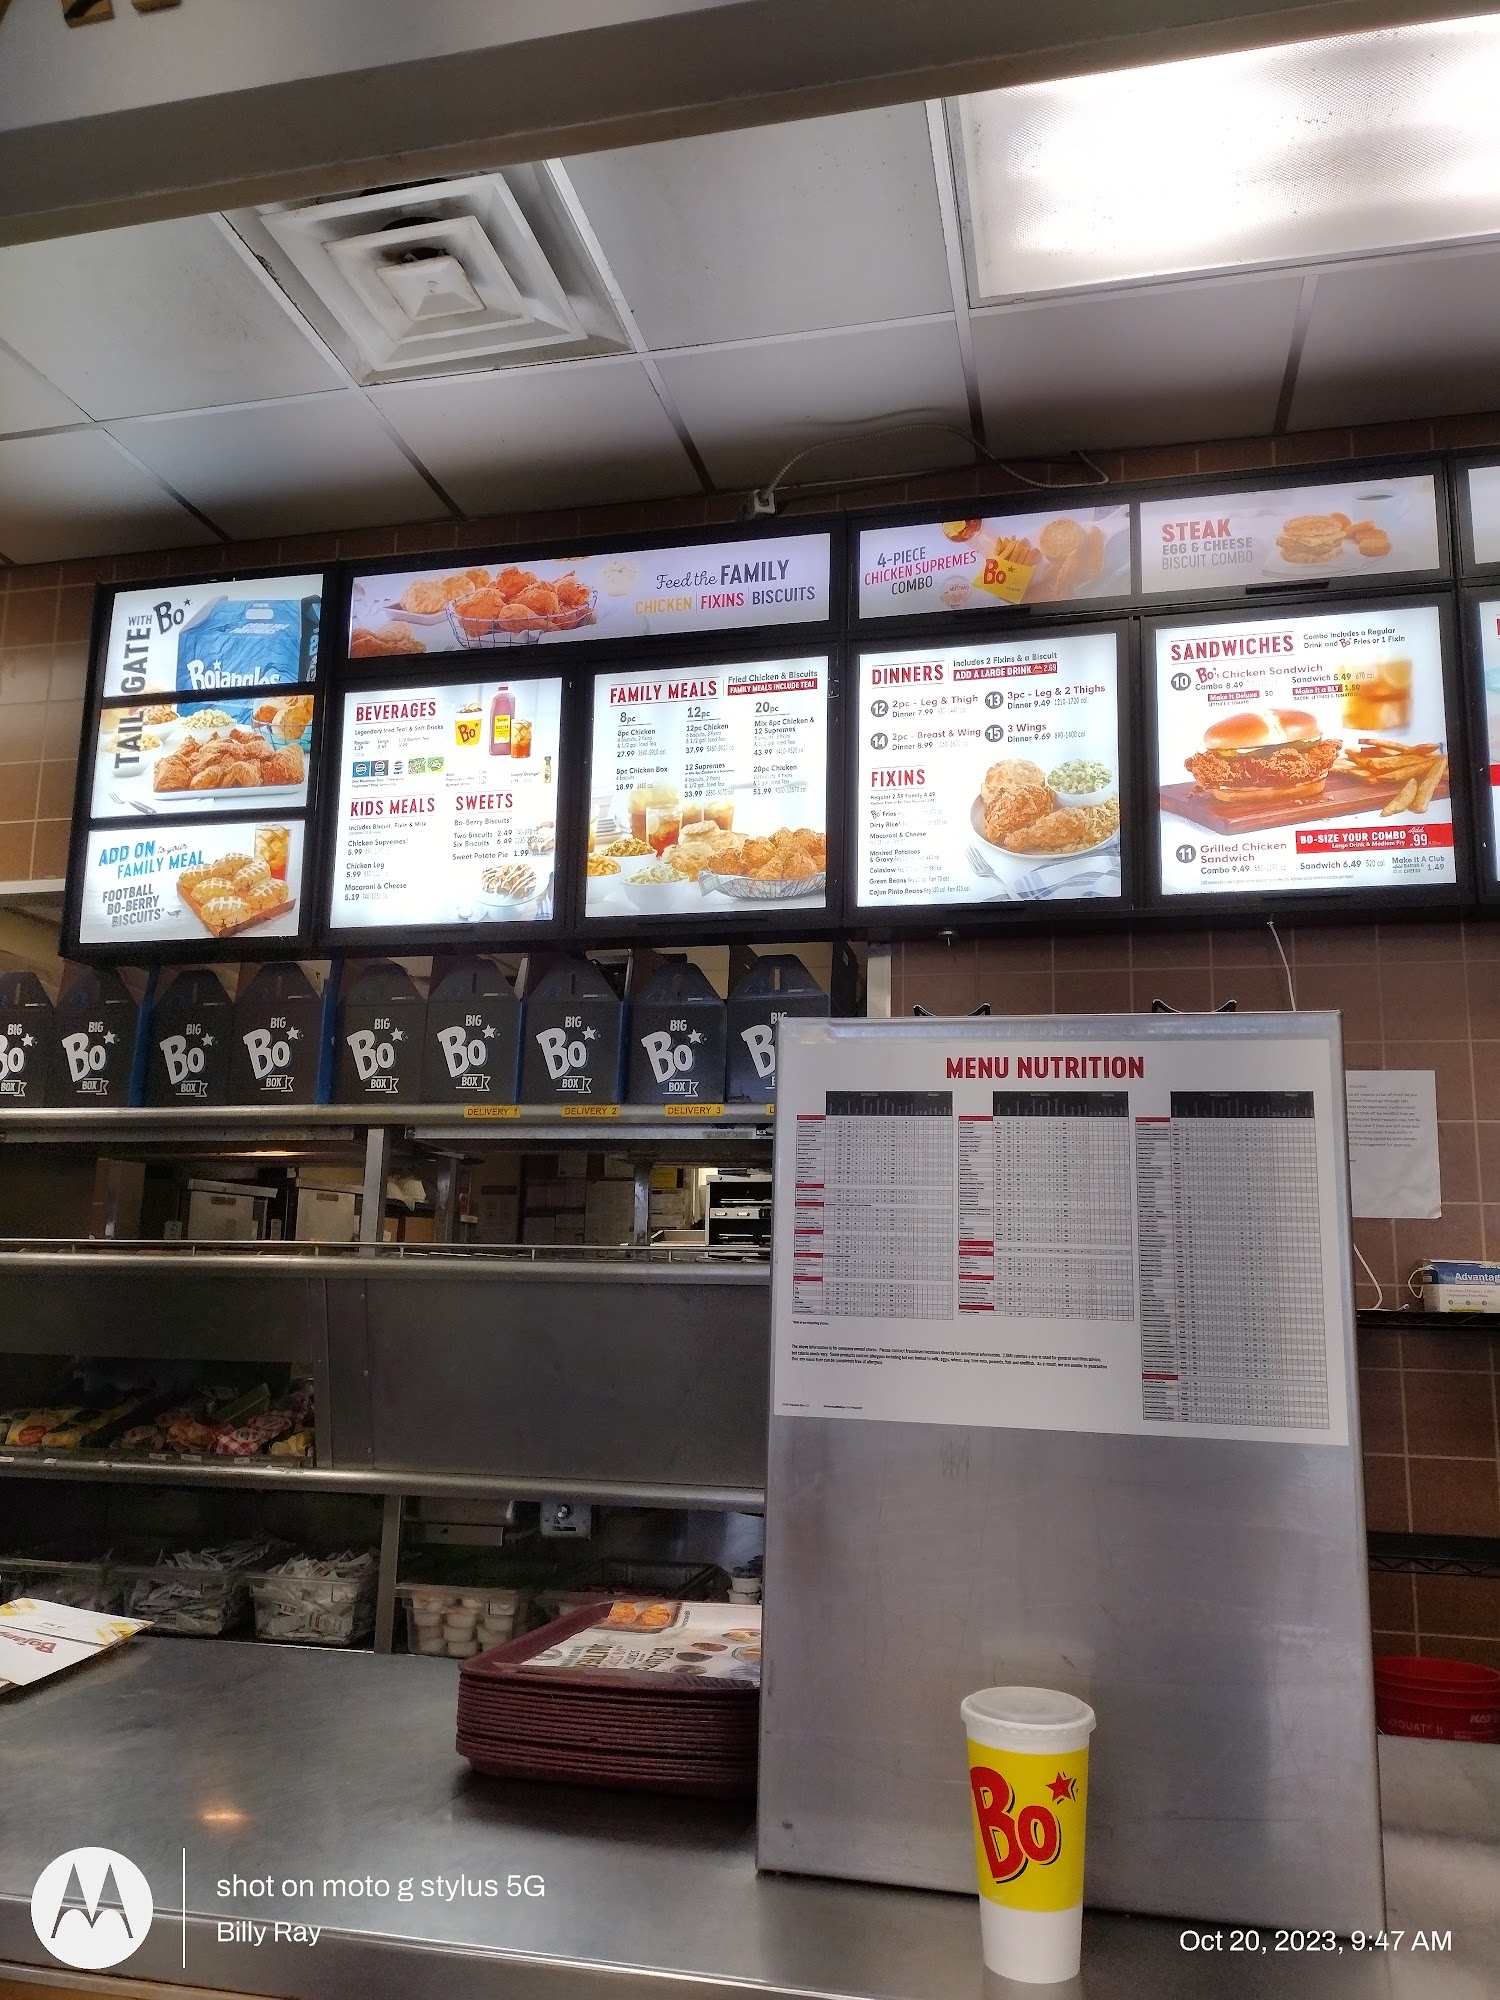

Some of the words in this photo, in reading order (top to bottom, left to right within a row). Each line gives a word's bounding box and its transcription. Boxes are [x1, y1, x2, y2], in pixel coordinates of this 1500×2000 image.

[1161, 518, 1232, 543] STEAK
[1162, 543, 1187, 556] EGG
[1191, 542, 1200, 553] &
[1204, 537, 1253, 552] CHEESE
[877, 546, 926, 568] 4-PIECE
[1162, 554, 1207, 570] BISCUIT
[1211, 550, 1254, 566] COMBO
[656, 571, 693, 590] Feed
[694, 570, 718, 587] the
[720, 559, 790, 586] FAMILY
[864, 564, 913, 586] CHICKEN
[891, 575, 933, 596] COMBO
[635, 596, 692, 616] CHICKEN
[700, 592, 745, 610] FIXINS
[752, 586, 816, 606] BISCUITS
[128, 614, 153, 626] WITH
[1171, 635, 1293, 661] SANDWICHES
[953, 658, 984, 668] Includes
[986, 657, 991, 665] 2
[993, 655, 1015, 665] Fixins
[1016, 654, 1023, 662] &
[1032, 652, 1058, 661] Biscuit
[728, 676, 747, 684] Fried
[748, 673, 779, 682] Chicken
[780, 671, 787, 680] &
[788, 669, 818, 679] Biscuits
[872, 664, 944, 685] DINNERS
[955, 669, 971, 680] ADD
[973, 669, 980, 679] A
[981, 667, 1005, 678] LARGE
[1007, 665, 1032, 676] DRINK
[1222, 669, 1266, 679] Chicken
[1269, 664, 1323, 675] Sandwich
[1291, 674, 1331, 684] Sandwich
[1333, 673, 1352, 681] 5.49
[610, 684, 662, 704] FAMILY
[668, 680, 717, 700] MEALS
[730, 685, 752, 694] FAMILY
[752, 683, 773, 693] MEALS
[773, 681, 799, 691] INCLUDE
[1007, 691, 1025, 701] 3pc
[1035, 689, 1052, 699] Leg
[1054, 687, 1062, 696] &
[1065, 686, 1071, 695] 2
[1073, 684, 1106, 696] Thighs
[1195, 682, 1223, 691] Combo
[1225, 681, 1244, 689] 8.49
[755, 701, 779, 714] 20pc
[892, 699, 910, 709] 2pc
[920, 698, 938, 708] Leg
[941, 696, 948, 704] &
[951, 694, 979, 705] Thigh
[1007, 701, 1032, 710] Dinner
[1034, 699, 1051, 708] 9.49
[356, 701, 436, 722] BEVERAGES
[620, 712, 636, 724] 8pc
[687, 706, 711, 719] 12pc
[1007, 724, 1014, 733] 3
[1016, 723, 1047, 733] Wings
[1007, 735, 1032, 744] Dinner
[1034, 733, 1051, 741] 9.69
[871, 768, 926, 788] FIXINS
[350, 799, 384, 817] KIDS
[389, 797, 435, 815] MEALS
[455, 793, 513, 811] SWEETS
[1300, 834, 1339, 845] BO-SIZE
[1341, 832, 1368, 842] YOUR
[1371, 830, 1407, 841] COMBO
[1332, 842, 1349, 850] Large
[1371, 840, 1396, 848] Medium
[1396, 839, 1405, 847] Fry
[98, 845, 130, 867] ADD
[134, 840, 156, 859] ON
[452, 852, 472, 861] Sweet
[474, 851, 496, 859] Potato
[514, 849, 529, 857] 1.99
[1200, 843, 1238, 853] Grilled
[1242, 842, 1287, 852] Chicken
[117, 857, 164, 879] FAMILY
[168, 850, 204, 870] MEAL
[1200, 853, 1255, 864] Sandwich
[1300, 861, 1341, 870] Sandwich
[1343, 860, 1362, 868] 6.49
[102, 883, 154, 904] FOOTBALL
[107, 895, 159, 916] BO-BERRY
[89, 1021, 104, 1033] BIG
[270, 1017, 287, 1029] BIG
[374, 1018, 391, 1030] BIG
[465, 1014, 482, 1027] BIG
[565, 1016, 582, 1028] BIG
[670, 1019, 687, 1031] BIG
[186, 1023, 202, 1035] BIG
[62, 1032, 106, 1084] Bo
[243, 1028, 291, 1080] Bo
[347, 1029, 396, 1081] Bo
[436, 1025, 487, 1079] Bo
[535, 1027, 587, 1081] Bo
[640, 1030, 693, 1084] Bo
[159, 1034, 205, 1086] Bo
[946, 1056, 1008, 1079] MENU
[1017, 1056, 1145, 1079] NUTRITION
[82, 1079, 98, 1092] BOX
[180, 1081, 197, 1093] BOX
[265, 1076, 282, 1088] BOX
[370, 1078, 388, 1090] BOX
[461, 1075, 478, 1088] BOX
[561, 1077, 579, 1089] BOX
[668, 1081, 686, 1092] BOX
[467, 1107, 508, 1116] DELIVERY
[513, 1107, 519, 1115] 1
[563, 1106, 607, 1116] DELIVERY
[611, 1106, 617, 1115] 2
[667, 1106, 711, 1115] DELIVERY
[716, 1106, 721, 1115] 3
[969, 1766, 1062, 1884] Bo
